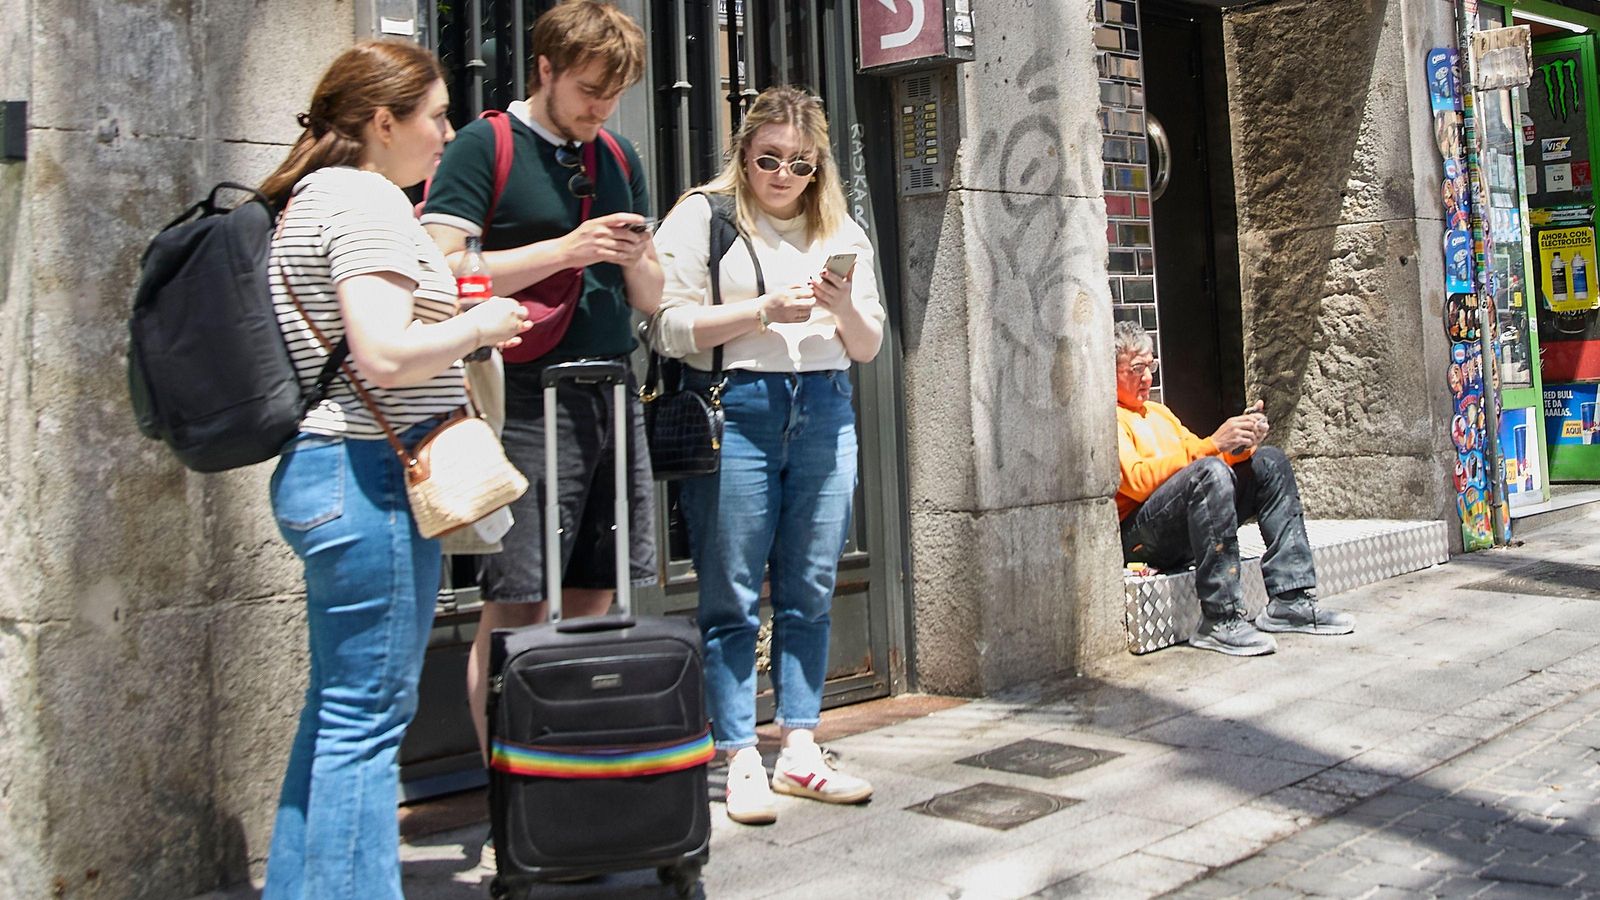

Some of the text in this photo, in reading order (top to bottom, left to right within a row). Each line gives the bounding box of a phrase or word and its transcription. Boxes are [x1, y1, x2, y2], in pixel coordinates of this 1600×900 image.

[1547, 142, 1567, 151] VISA
[1541, 230, 1587, 241] AHORA CON
[1541, 236, 1592, 247] ELECTROLITOS
[1543, 390, 1573, 399] RED BULL
[1544, 399, 1562, 408] TE DA
